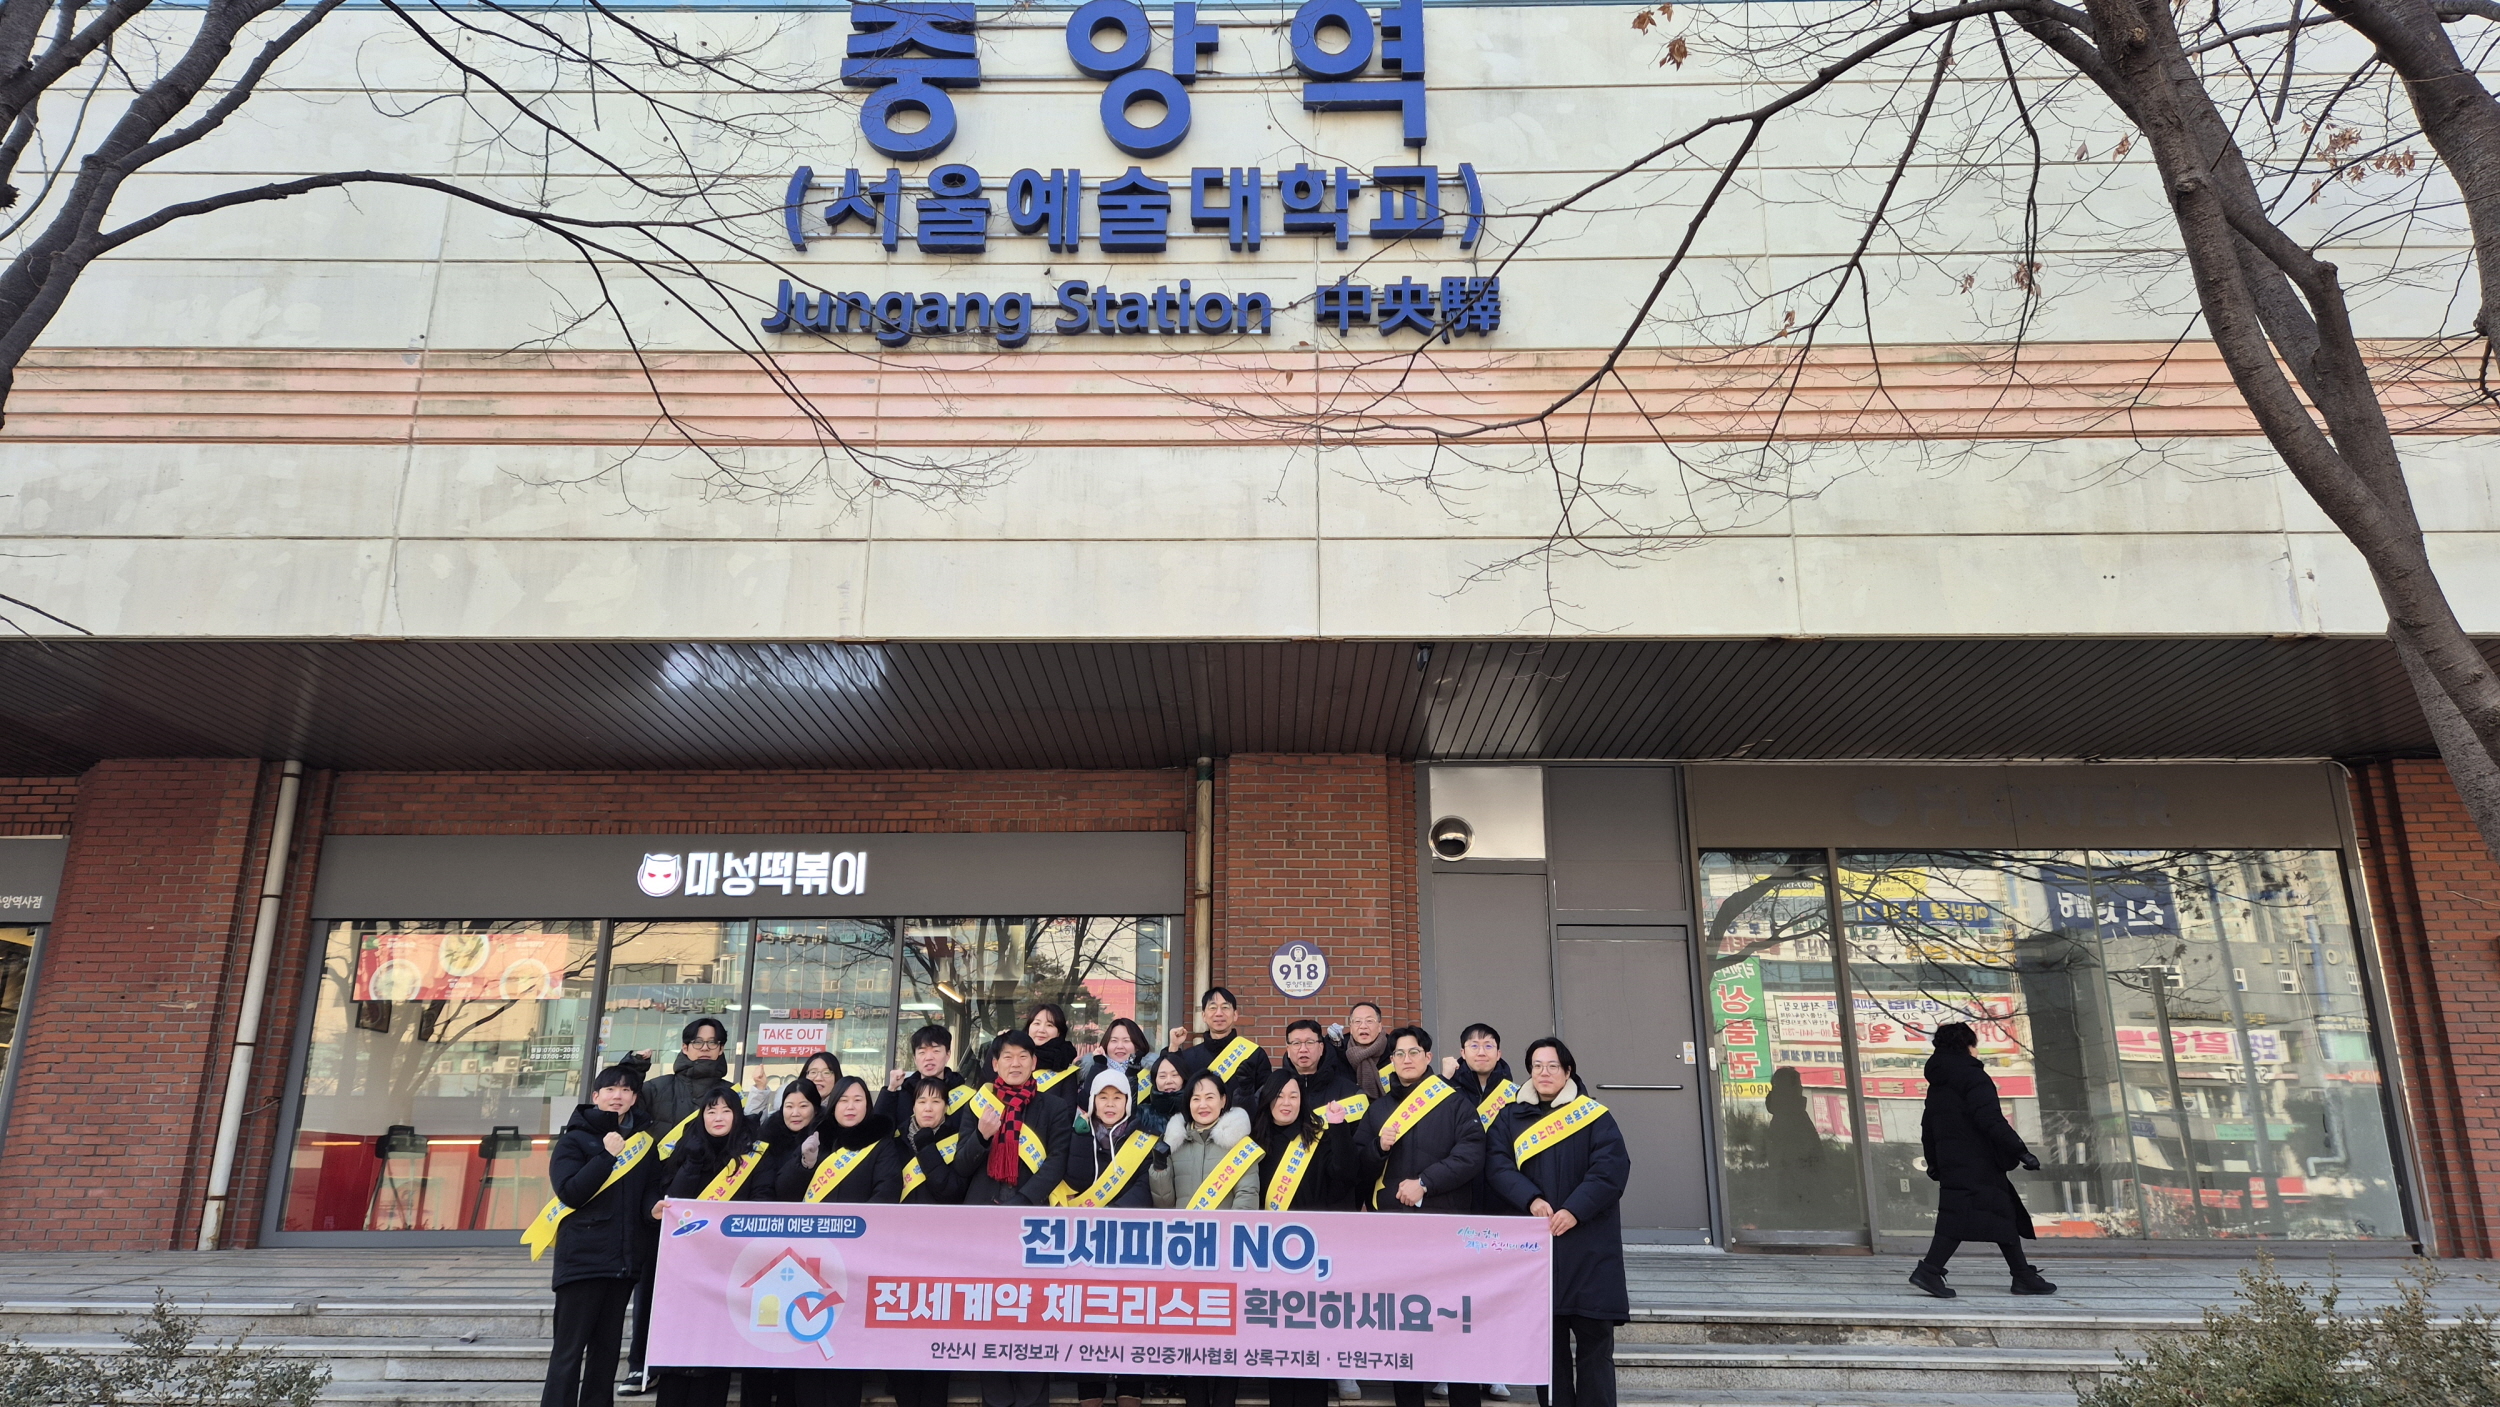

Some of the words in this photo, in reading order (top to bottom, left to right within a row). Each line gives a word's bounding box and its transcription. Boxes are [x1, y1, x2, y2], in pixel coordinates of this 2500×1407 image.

[840, 0, 1426, 161] 중앙역
[785, 162, 1486, 254] (서울예술대학교)
[761, 278, 1033, 348] Jungang
[1055, 278, 1273, 337] Station
[1316, 275, 1502, 344] 中央驛
[684, 851, 867, 897] 마성떡볶이
[0, 895, 43, 909] 앙역사점
[1279, 963, 1319, 981] 918
[761, 1046, 769, 1056] 전
[771, 1046, 787, 1056] 메뉴
[763, 1029, 793, 1040] TAKE
[797, 1029, 823, 1040] OUT
[730, 1217, 785, 1233] 전세피해
[787, 1217, 815, 1233] 예방
[816, 1218, 857, 1234] 캠페인
[1022, 1217, 1218, 1268] 전세피해
[1230, 1222, 1332, 1280] NO,
[873, 1281, 1032, 1323] 전세계약
[1041, 1284, 1232, 1328] 체크리스트
[1243, 1287, 1472, 1333] 확인하세요~!
[930, 1341, 977, 1360] 안산시
[982, 1343, 1060, 1362] 토지정보과
[1079, 1345, 1125, 1364] 안산시
[1130, 1345, 1238, 1366] 공인중개사협회
[1243, 1346, 1320, 1368] 상록구지회
[1337, 1349, 1414, 1371] 단원구지회
